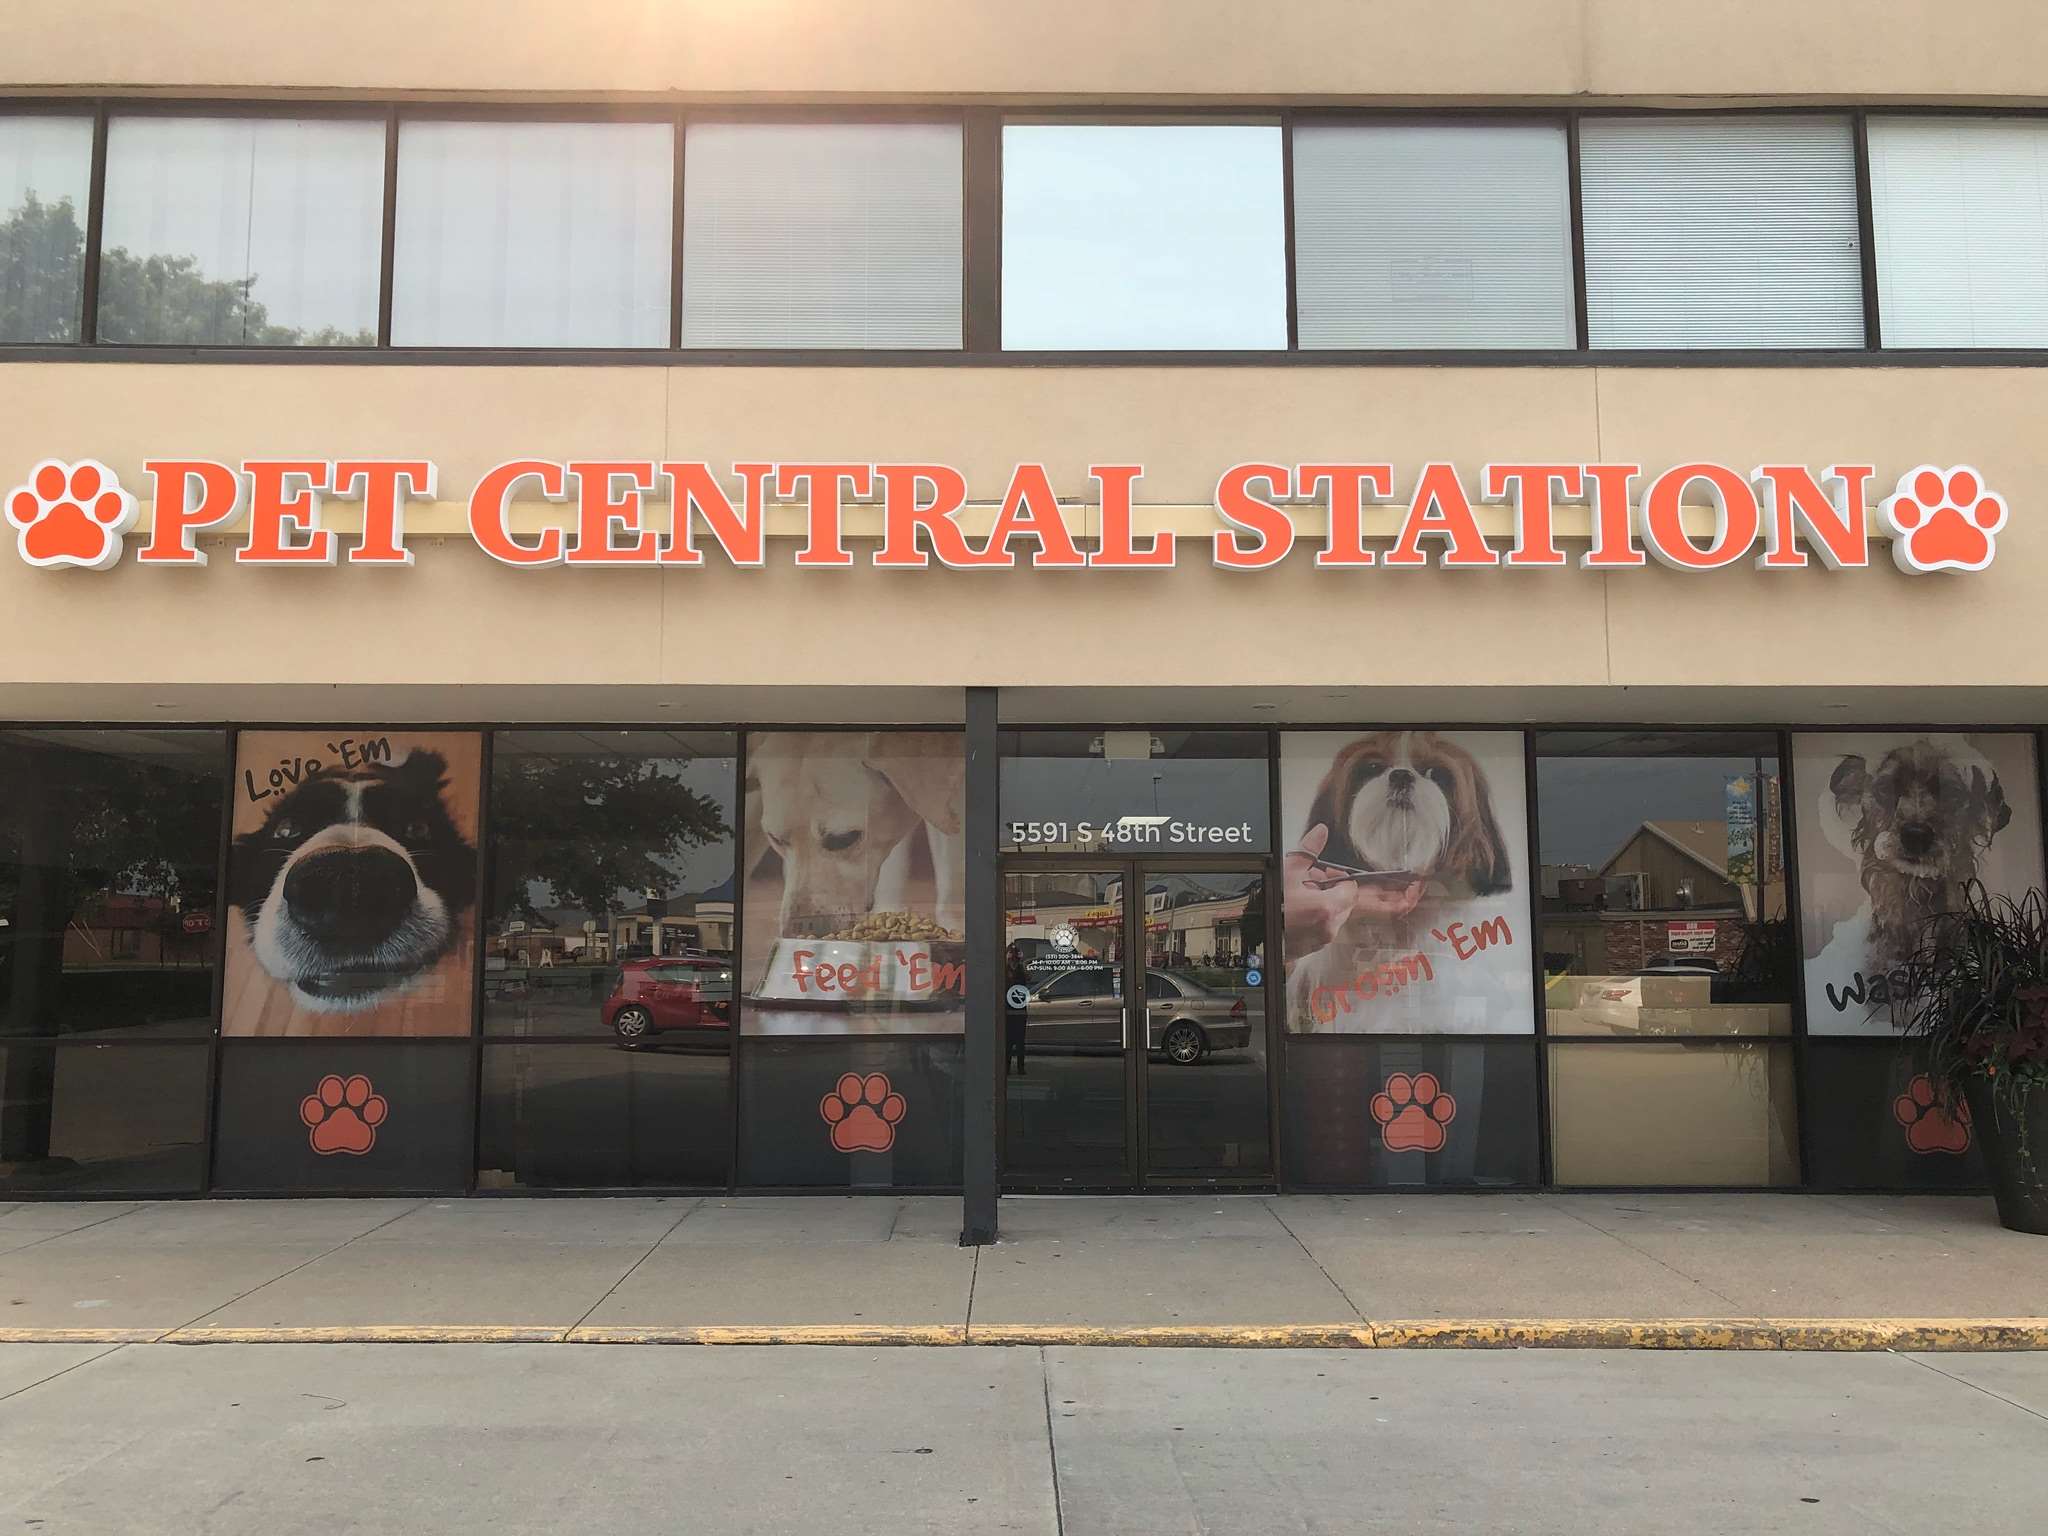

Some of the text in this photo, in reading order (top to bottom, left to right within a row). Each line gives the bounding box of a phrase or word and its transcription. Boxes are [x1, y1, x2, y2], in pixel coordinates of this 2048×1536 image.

[137, 458, 1877, 568] PET CENTRAL STATION
[245, 757, 322, 802] Love
[1012, 822, 1253, 843] 5591 S 48th Street
[792, 950, 881, 993] Feed
[1311, 952, 1434, 1025] Groom
